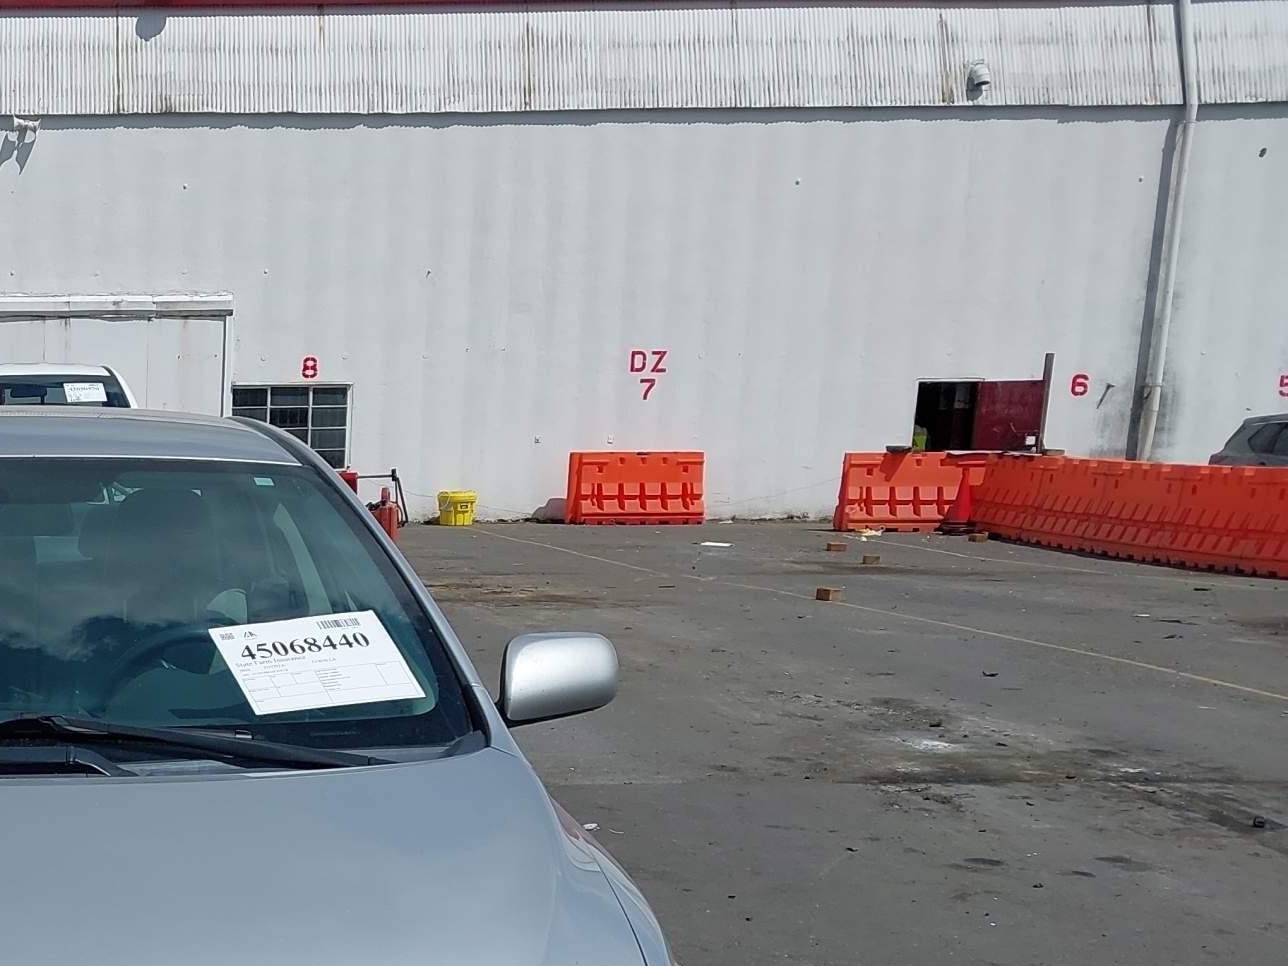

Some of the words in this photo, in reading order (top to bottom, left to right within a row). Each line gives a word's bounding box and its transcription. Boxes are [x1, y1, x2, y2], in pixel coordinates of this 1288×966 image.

[302, 356, 318, 379] 8
[630, 350, 668, 373] DZ
[639, 378, 656, 401] 7
[1071, 373, 1089, 397] 6
[241, 632, 370, 660] 45068440
